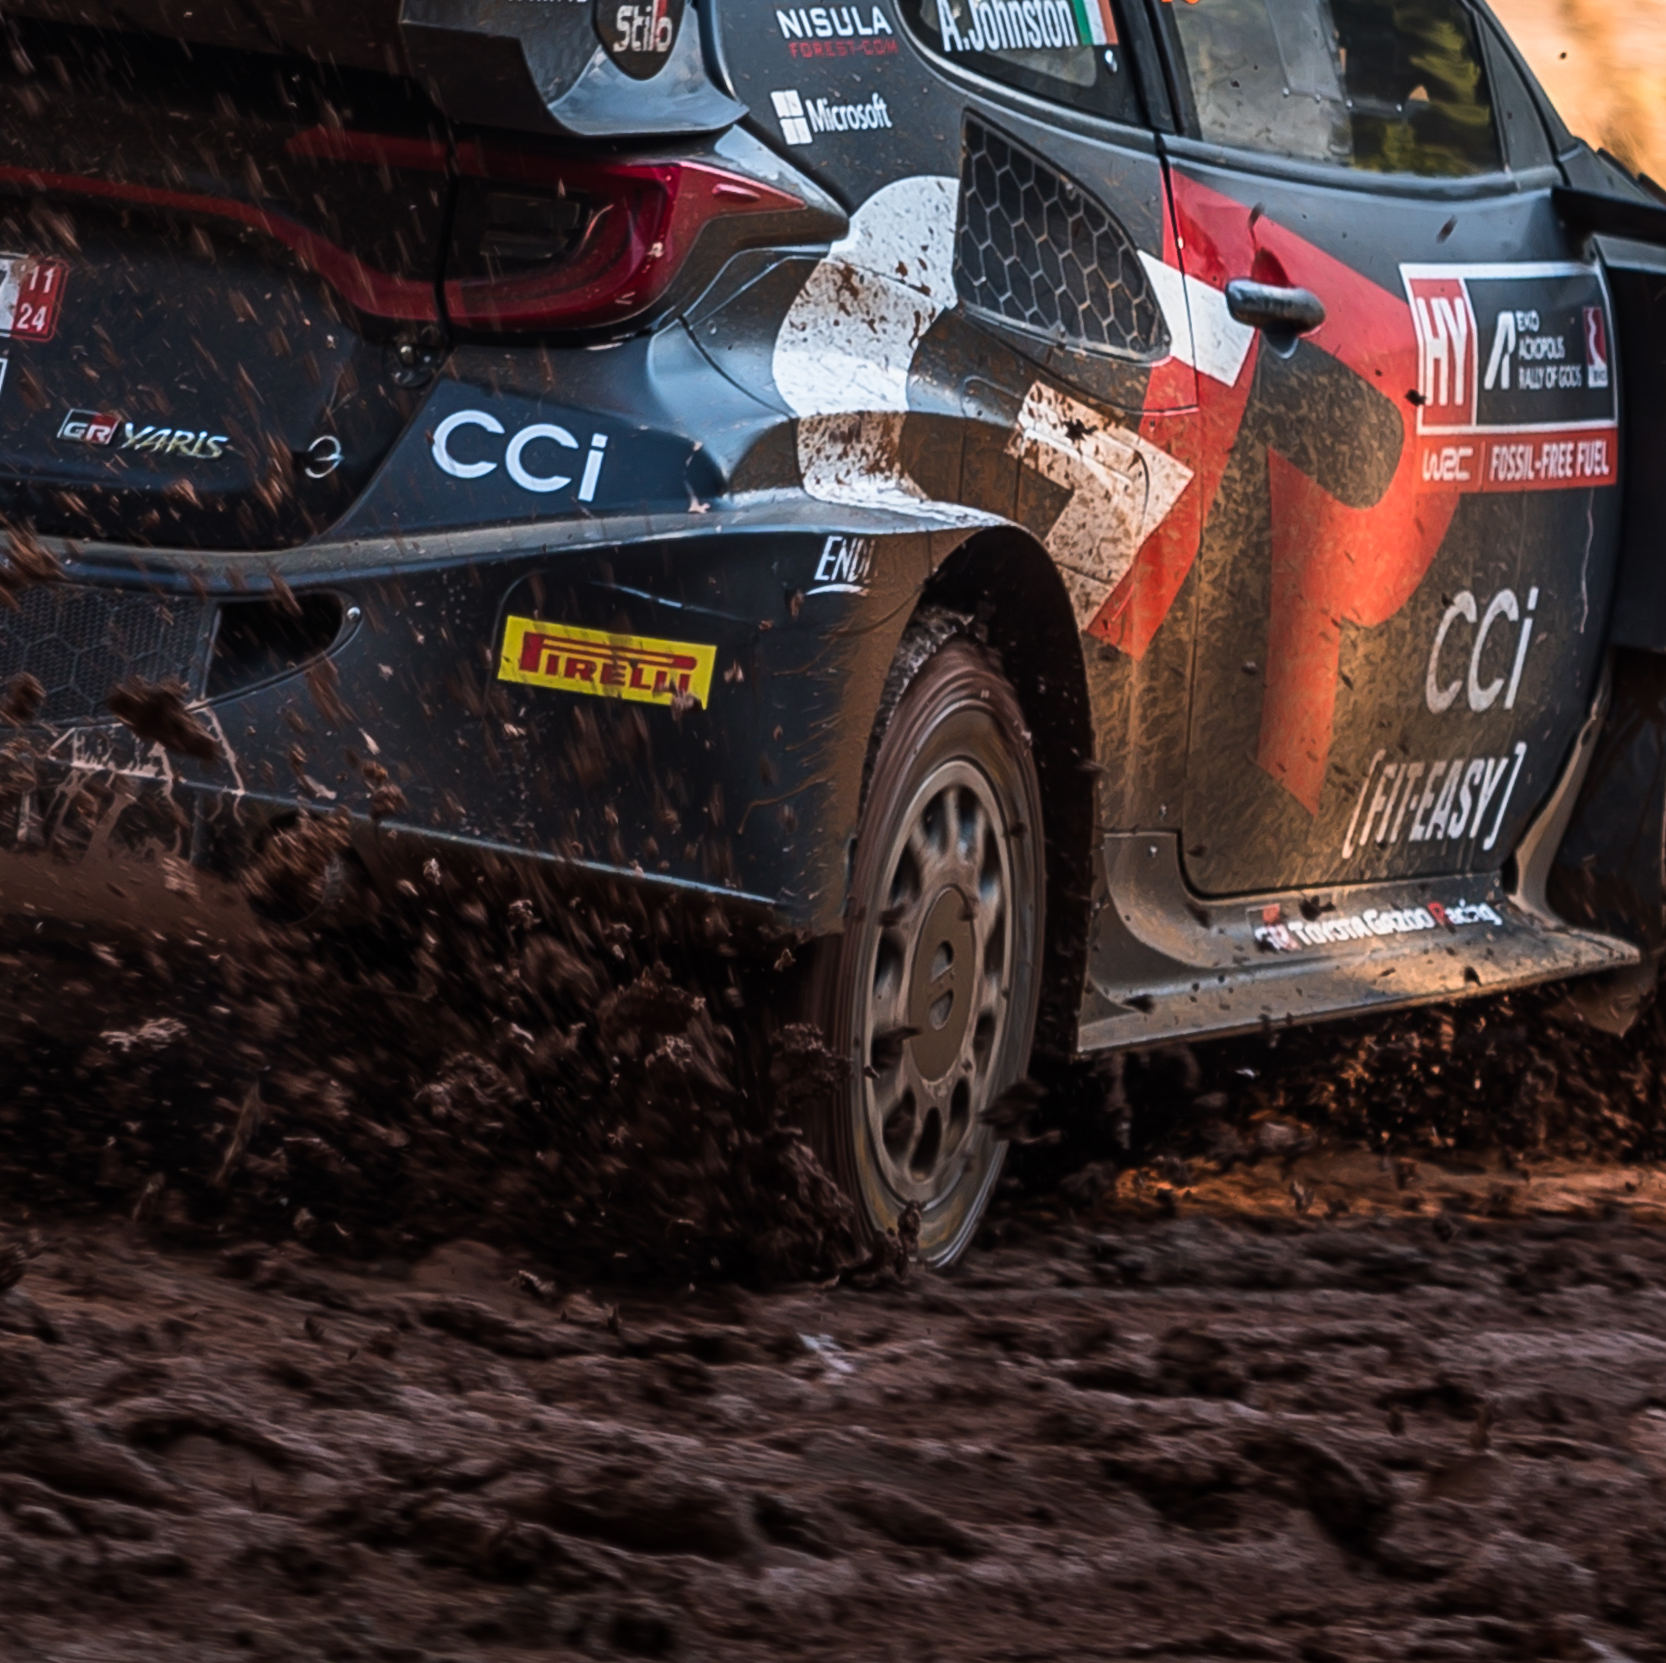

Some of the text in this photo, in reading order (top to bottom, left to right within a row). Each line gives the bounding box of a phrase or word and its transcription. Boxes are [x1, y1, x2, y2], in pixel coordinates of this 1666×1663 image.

[776, 6, 893, 39] NISULA
[805, 92, 893, 134] Microsoft
[28, 265, 54, 294] 11
[16, 302, 47, 333] 24
[1416, 297, 1467, 407] HY
[1518, 336, 1566, 361] ACROPOLIS
[1545, 365, 1558, 390] OF
[63, 421, 112, 444] GR
[1422, 438, 1610, 483] WRC FOSSIL-FREE FUEL
[519, 631, 698, 694] PIRELLI
[1288, 915, 1373, 946] TOYOTA
